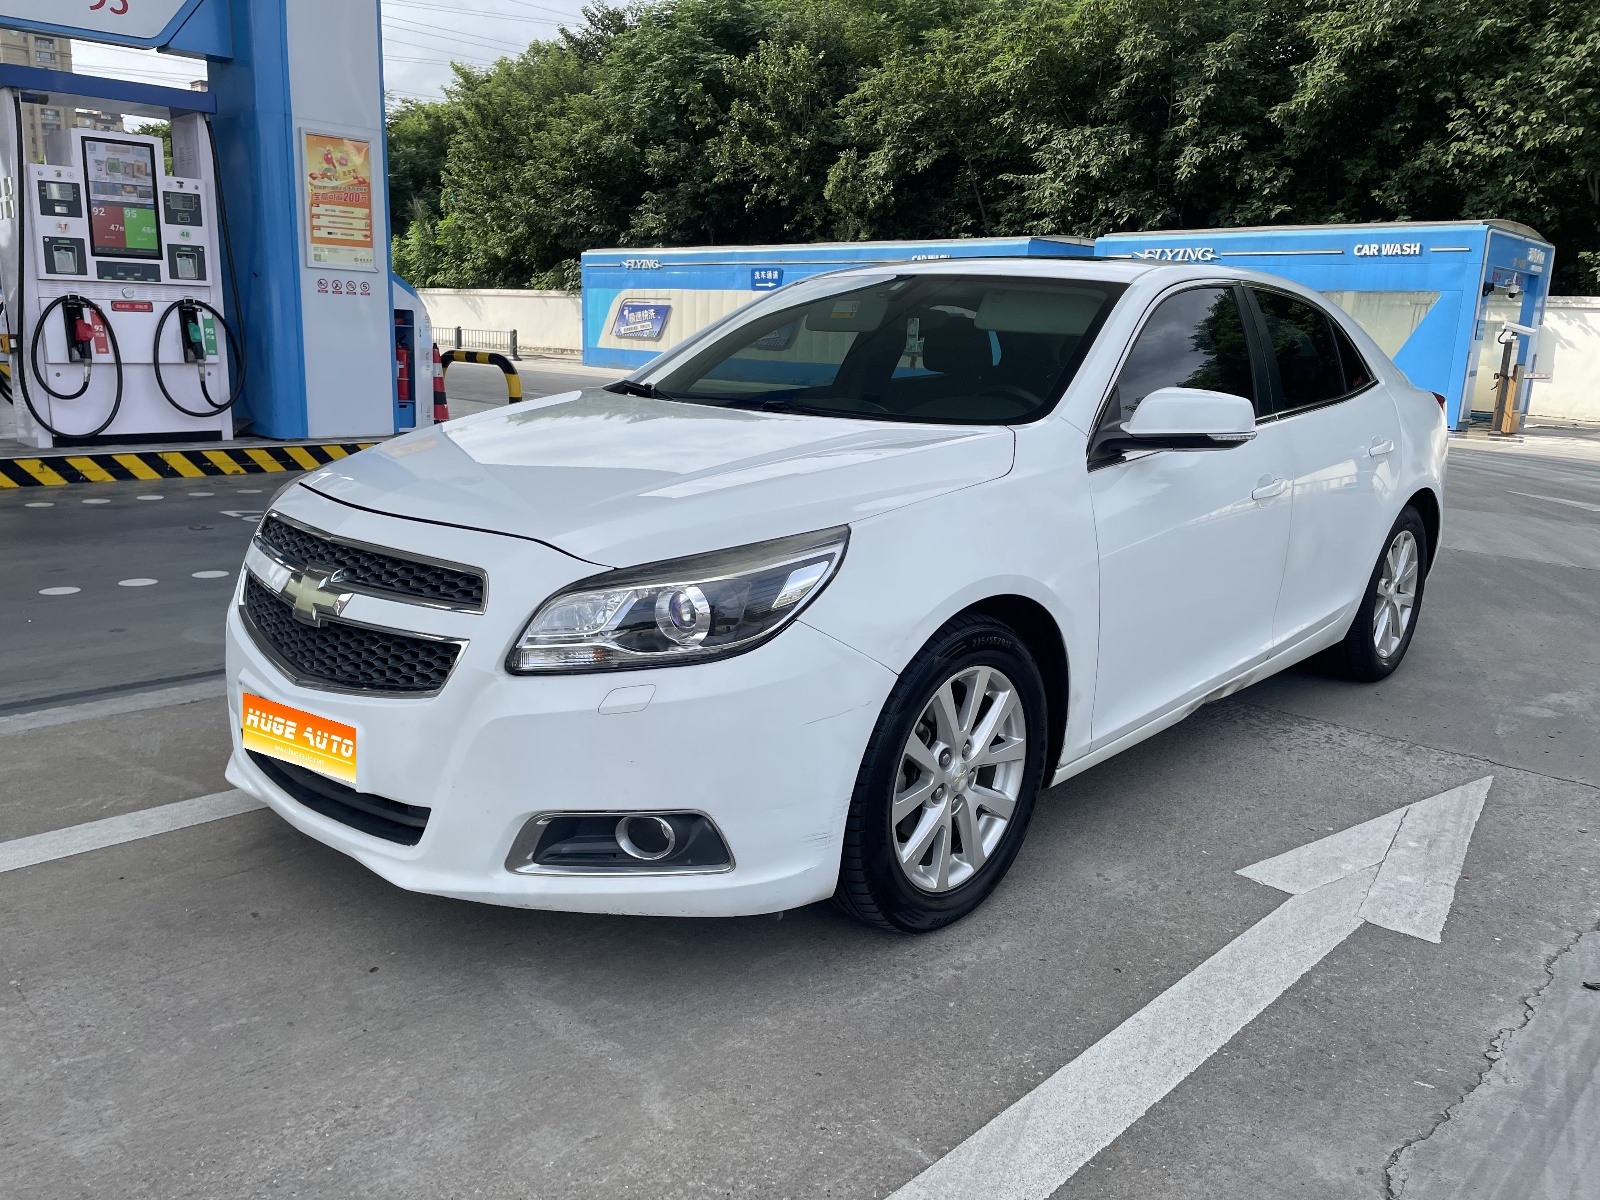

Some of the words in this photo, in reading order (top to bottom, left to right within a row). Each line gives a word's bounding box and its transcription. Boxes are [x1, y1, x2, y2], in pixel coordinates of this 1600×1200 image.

[92, 207, 106, 216] 92
[124, 209, 137, 218] 95
[1353, 243, 1379, 256] CAR
[1381, 242, 1421, 256] WASH
[1140, 247, 1216, 261] FLYING
[624, 259, 660, 269] FLYING
[94, 324, 104, 332] 92
[205, 327, 214, 335] 95
